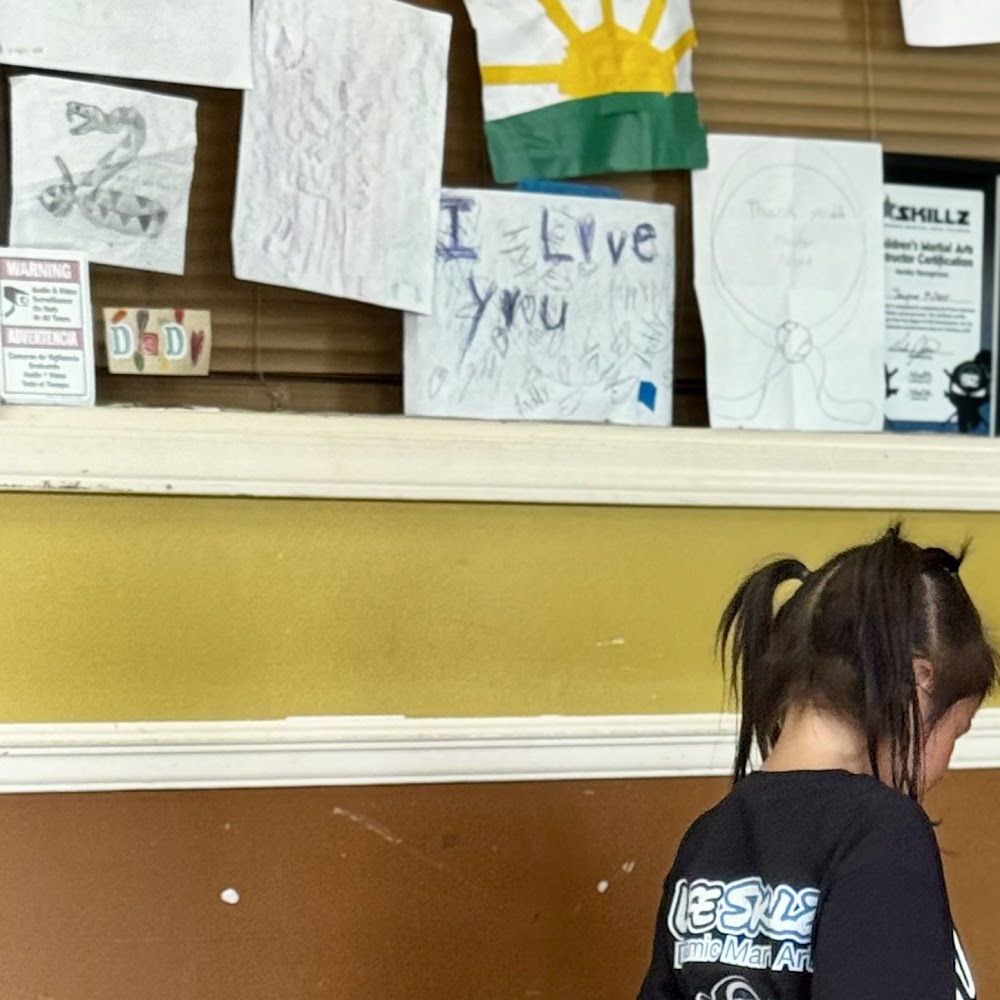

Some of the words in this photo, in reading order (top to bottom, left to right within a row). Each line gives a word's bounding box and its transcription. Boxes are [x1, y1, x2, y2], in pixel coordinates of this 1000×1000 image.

[896, 206, 970, 226] SKILLZ
[436, 197, 478, 260] I
[6, 260, 72, 279] WARNING
